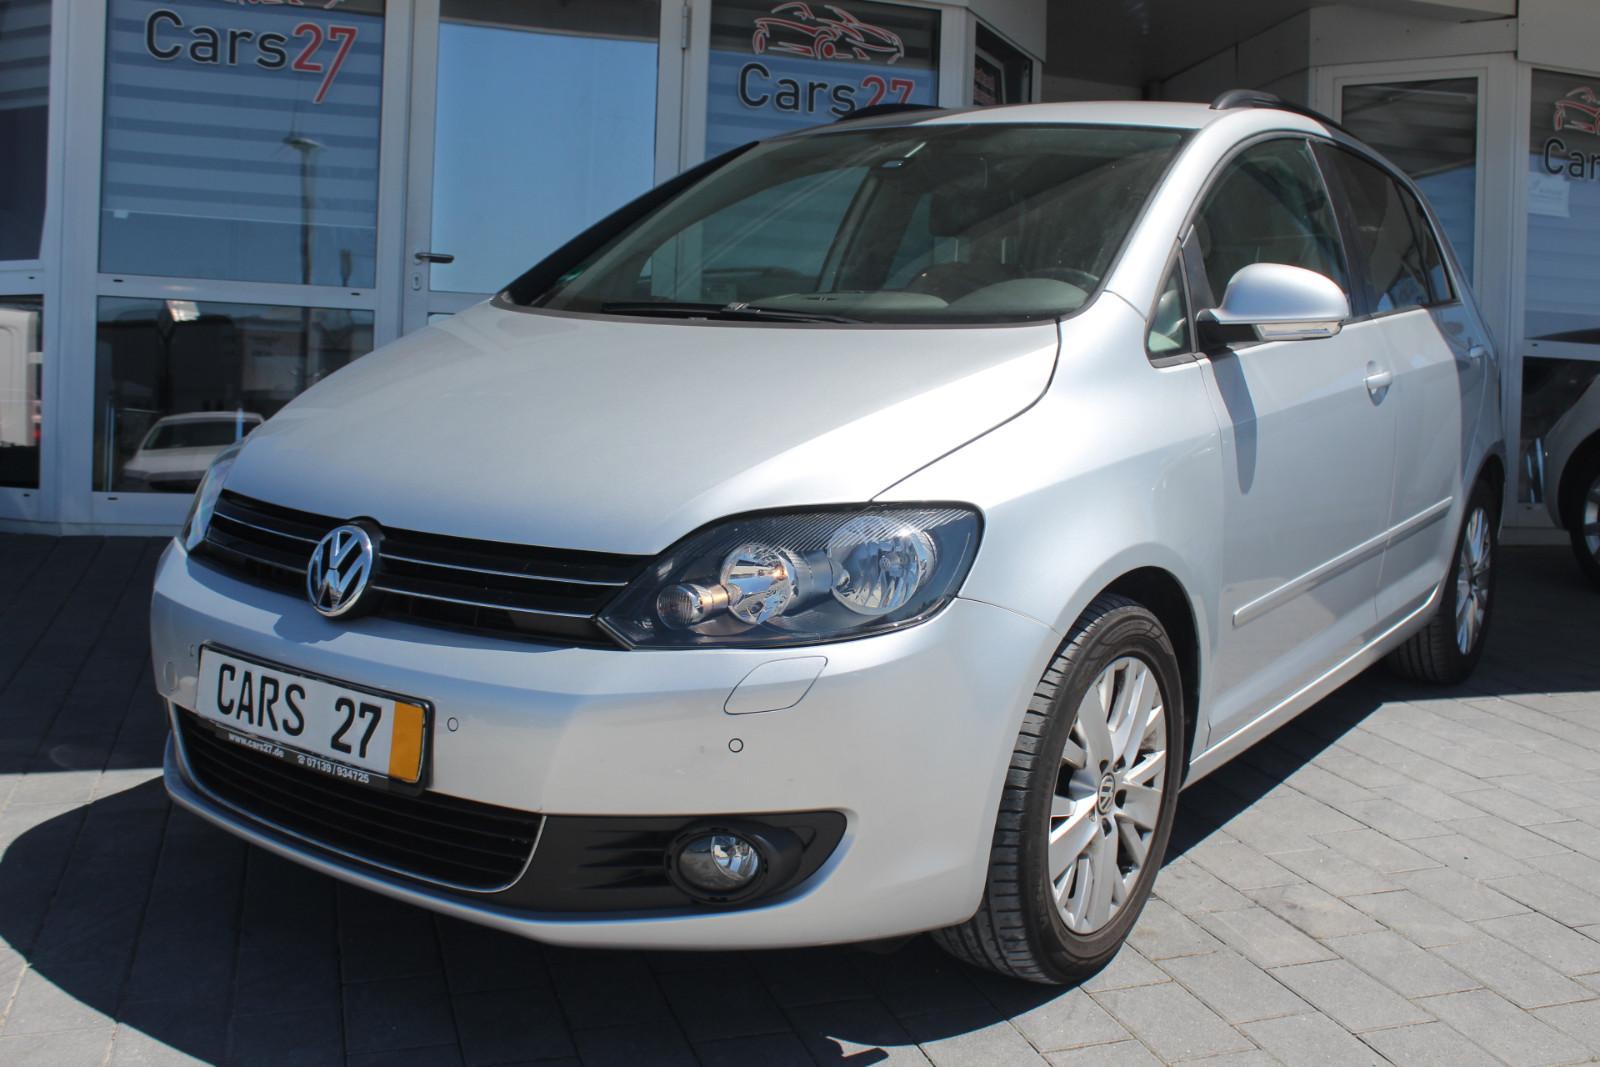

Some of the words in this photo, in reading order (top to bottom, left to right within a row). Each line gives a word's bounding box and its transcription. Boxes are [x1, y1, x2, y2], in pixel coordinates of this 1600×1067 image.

[145, 8, 358, 104] Cars27
[217, 663, 306, 737] CARS
[330, 697, 382, 759] 27
[228, 732, 285, 758] www.cars27.de
